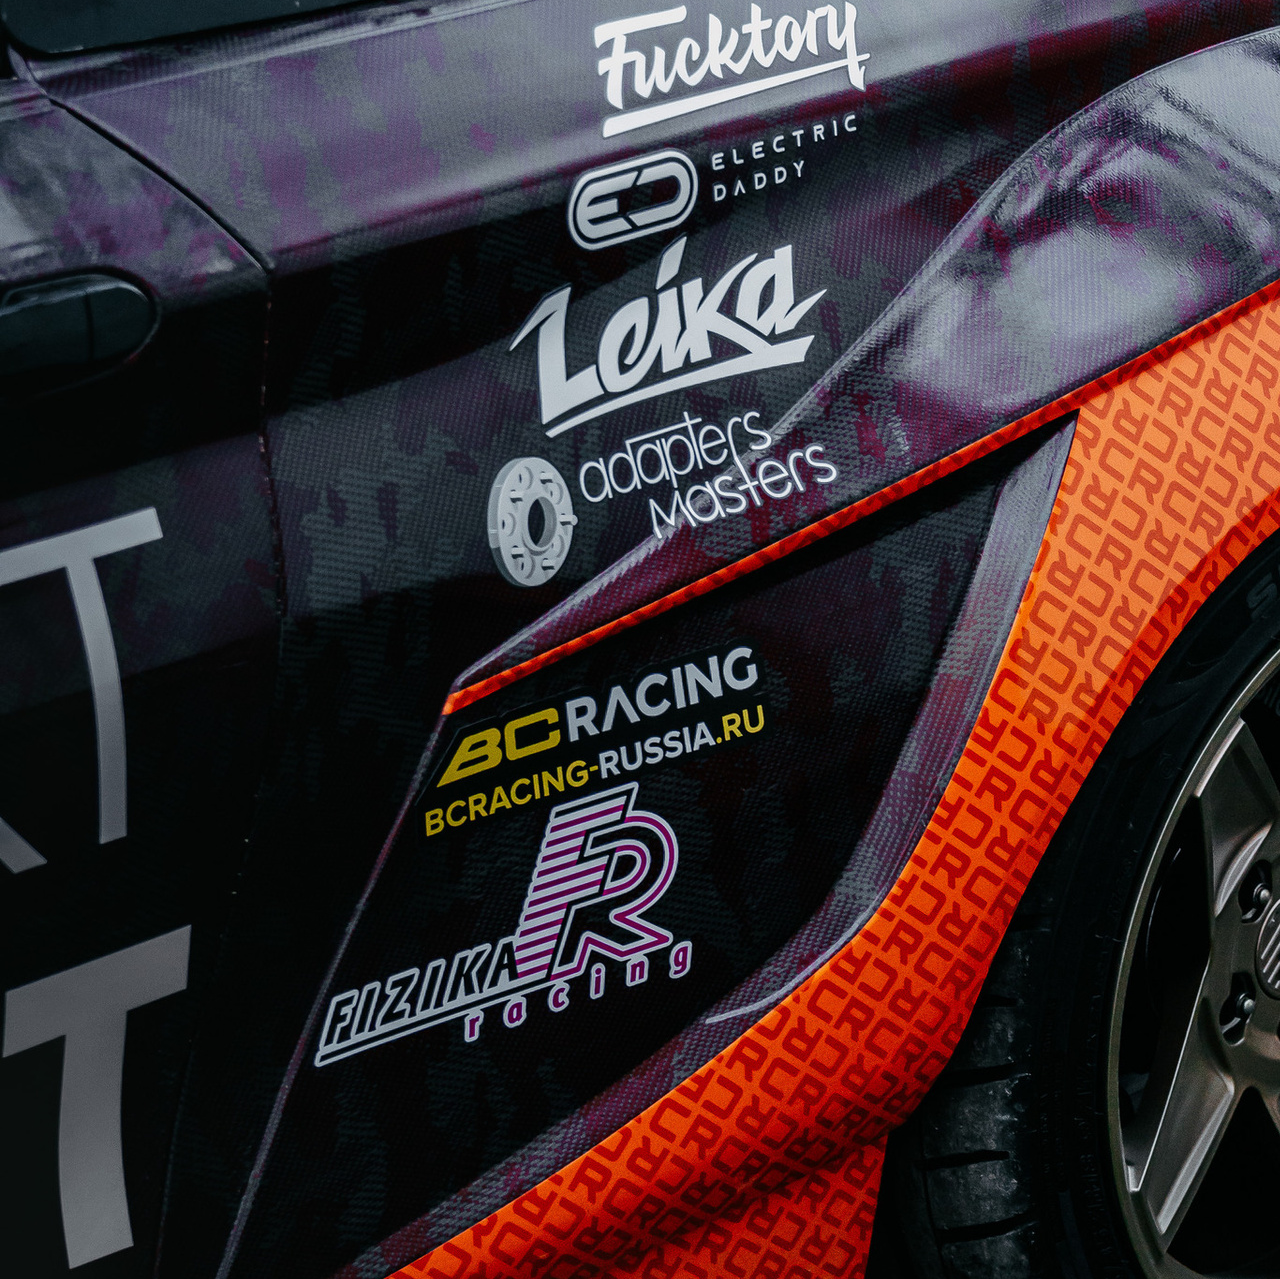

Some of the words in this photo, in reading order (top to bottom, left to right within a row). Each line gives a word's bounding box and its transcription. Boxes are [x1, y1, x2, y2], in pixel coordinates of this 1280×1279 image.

[594, 1, 868, 112] Fucktory
[711, 114, 858, 171] ELECTRIC
[713, 160, 806, 203] DADDY
[579, 411, 773, 503] adapters
[649, 445, 838, 539] Masters
[424, 704, 766, 837] BCRACING-RUSSIA.RU
[318, 935, 522, 1053] FIZIKA
[464, 940, 693, 1042] racing
